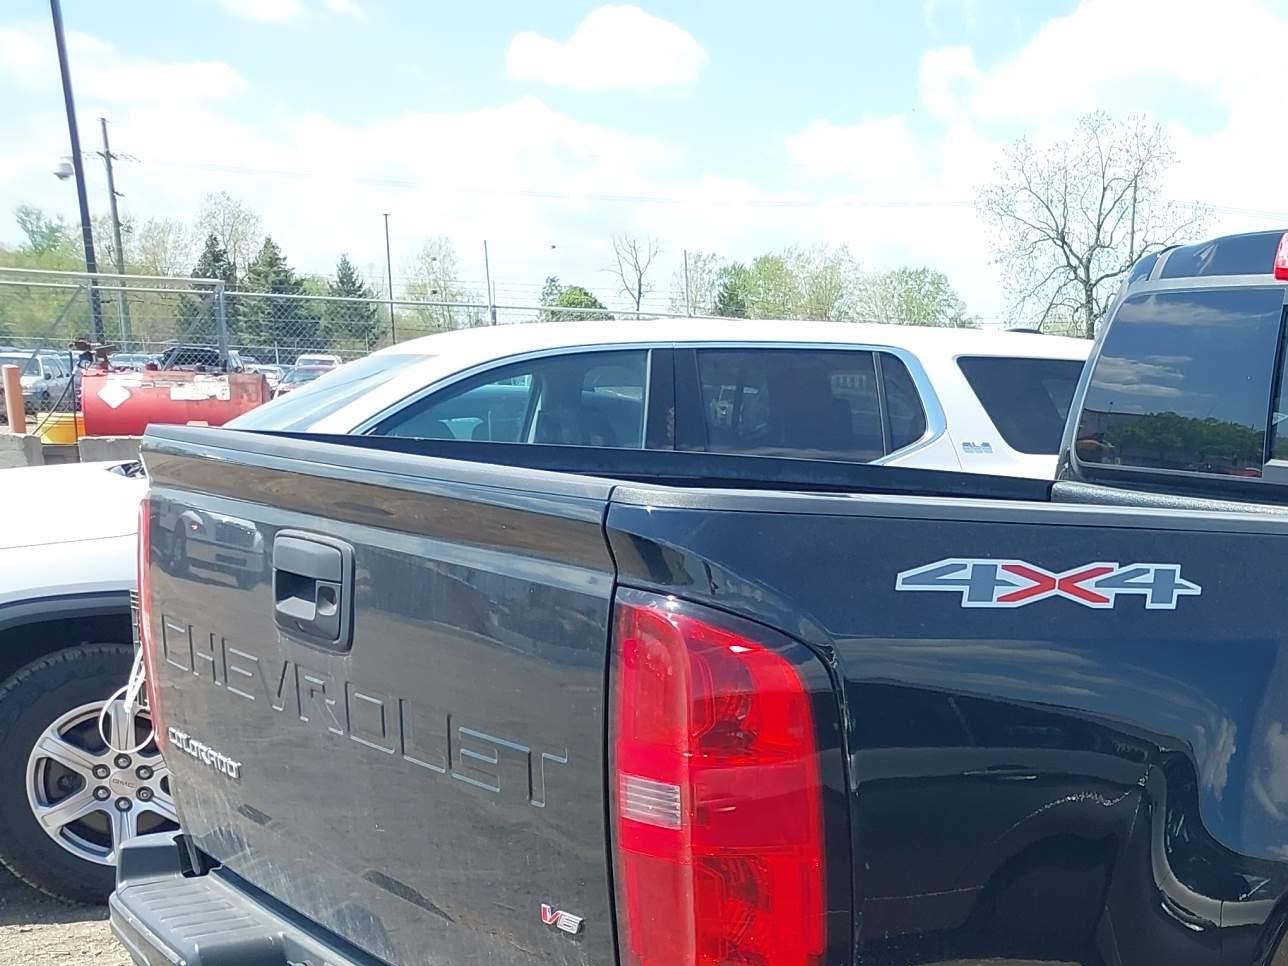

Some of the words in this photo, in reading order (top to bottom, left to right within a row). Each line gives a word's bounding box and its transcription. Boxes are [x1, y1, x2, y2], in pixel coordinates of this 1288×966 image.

[161, 613, 569, 808] CHEVROLET
[168, 727, 242, 779] COLORADO
[112, 778, 138, 789] GMC
[540, 903, 584, 935] V6
